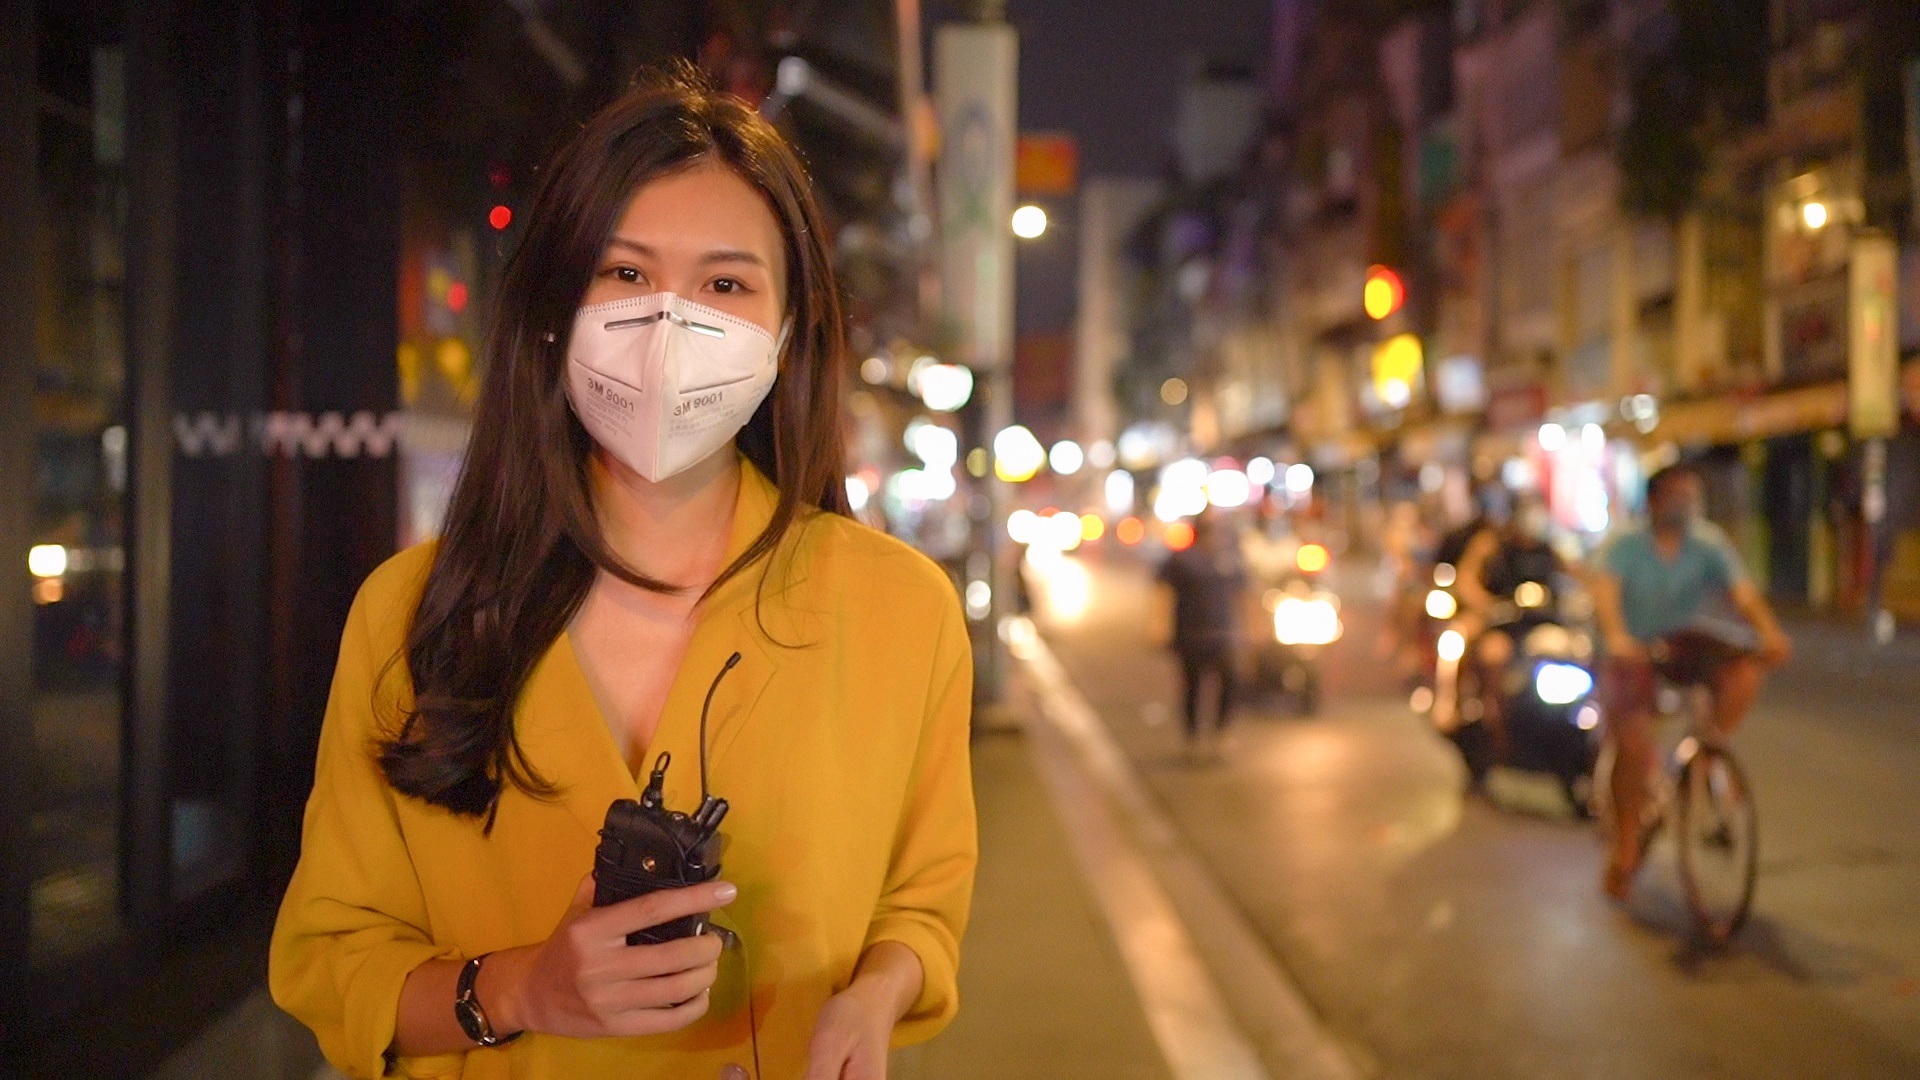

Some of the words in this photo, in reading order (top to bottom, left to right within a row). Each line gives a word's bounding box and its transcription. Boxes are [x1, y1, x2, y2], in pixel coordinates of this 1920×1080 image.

[587, 377, 604, 396] 3M
[606, 388, 634, 412] 9001
[673, 400, 691, 416] 3M
[693, 391, 723, 409] 9001
